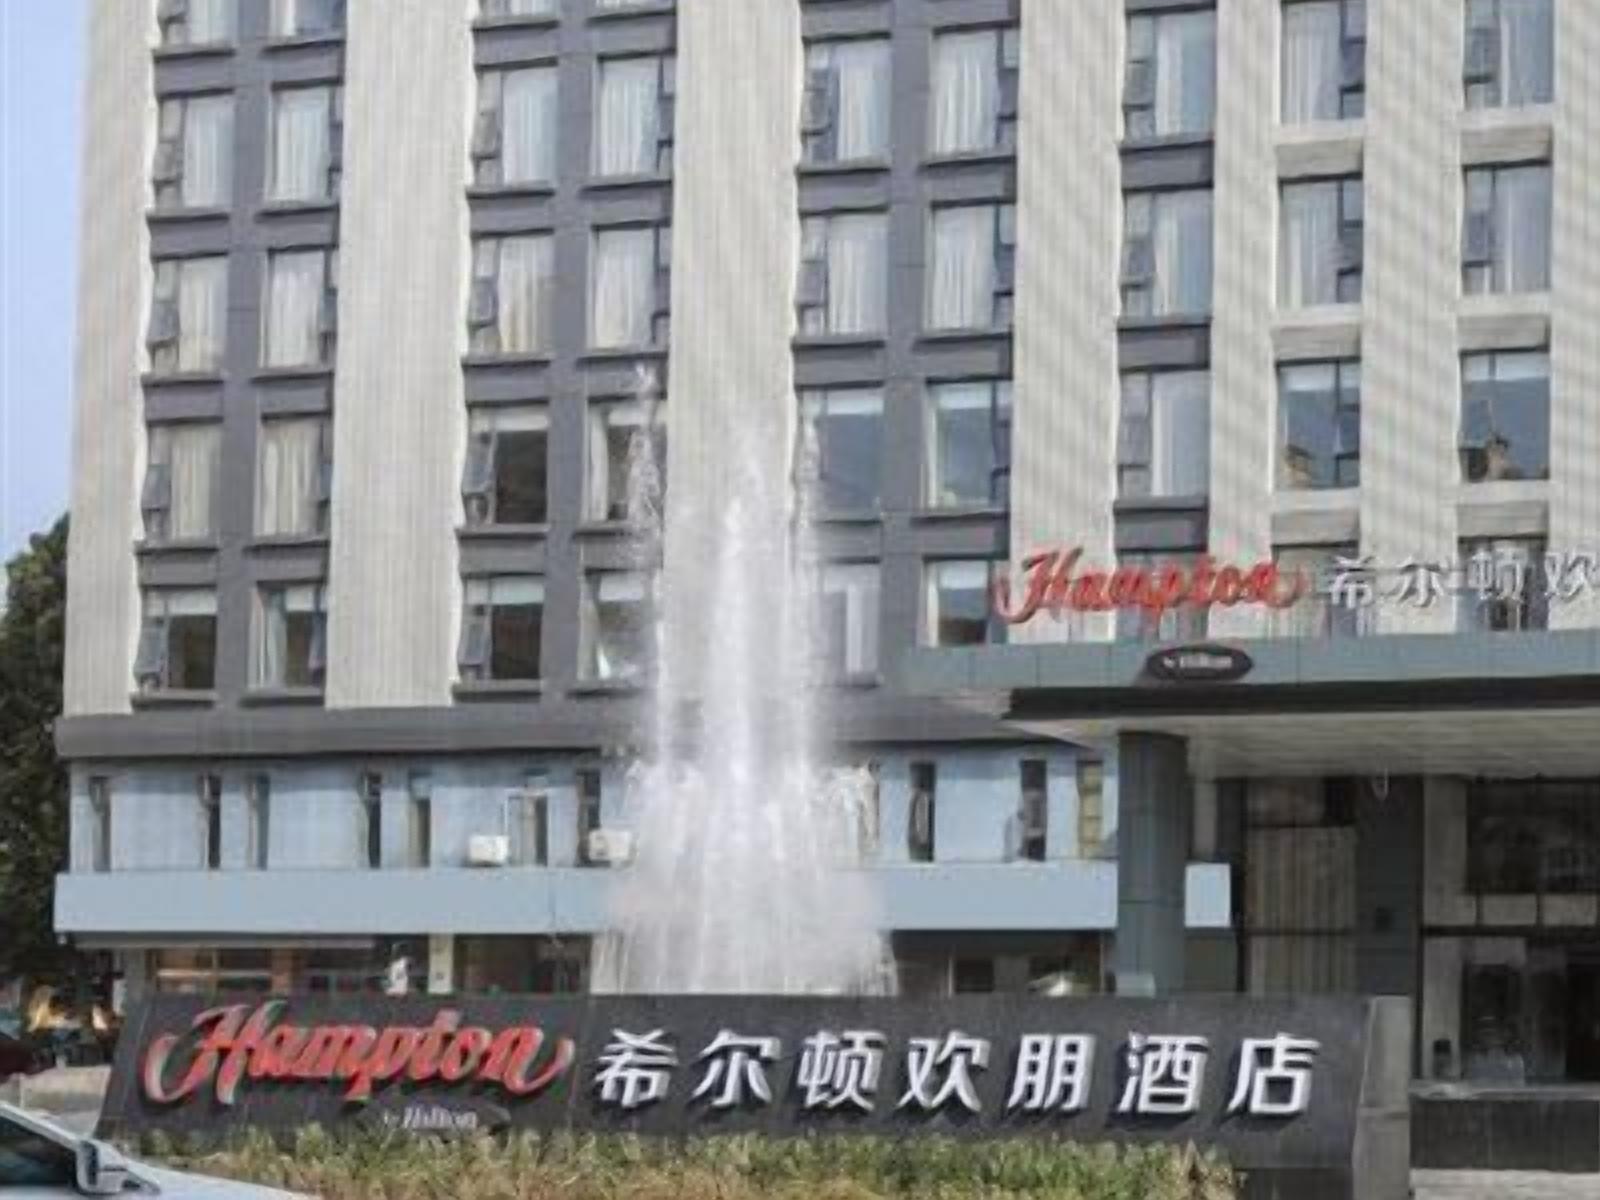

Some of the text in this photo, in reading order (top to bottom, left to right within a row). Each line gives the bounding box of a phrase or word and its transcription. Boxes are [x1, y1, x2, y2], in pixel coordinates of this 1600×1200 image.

[990, 547, 1308, 624] Hampton
[143, 999, 575, 1104] Hampton
[594, 1028, 1321, 1115] 希尔顿欢朋酒店
